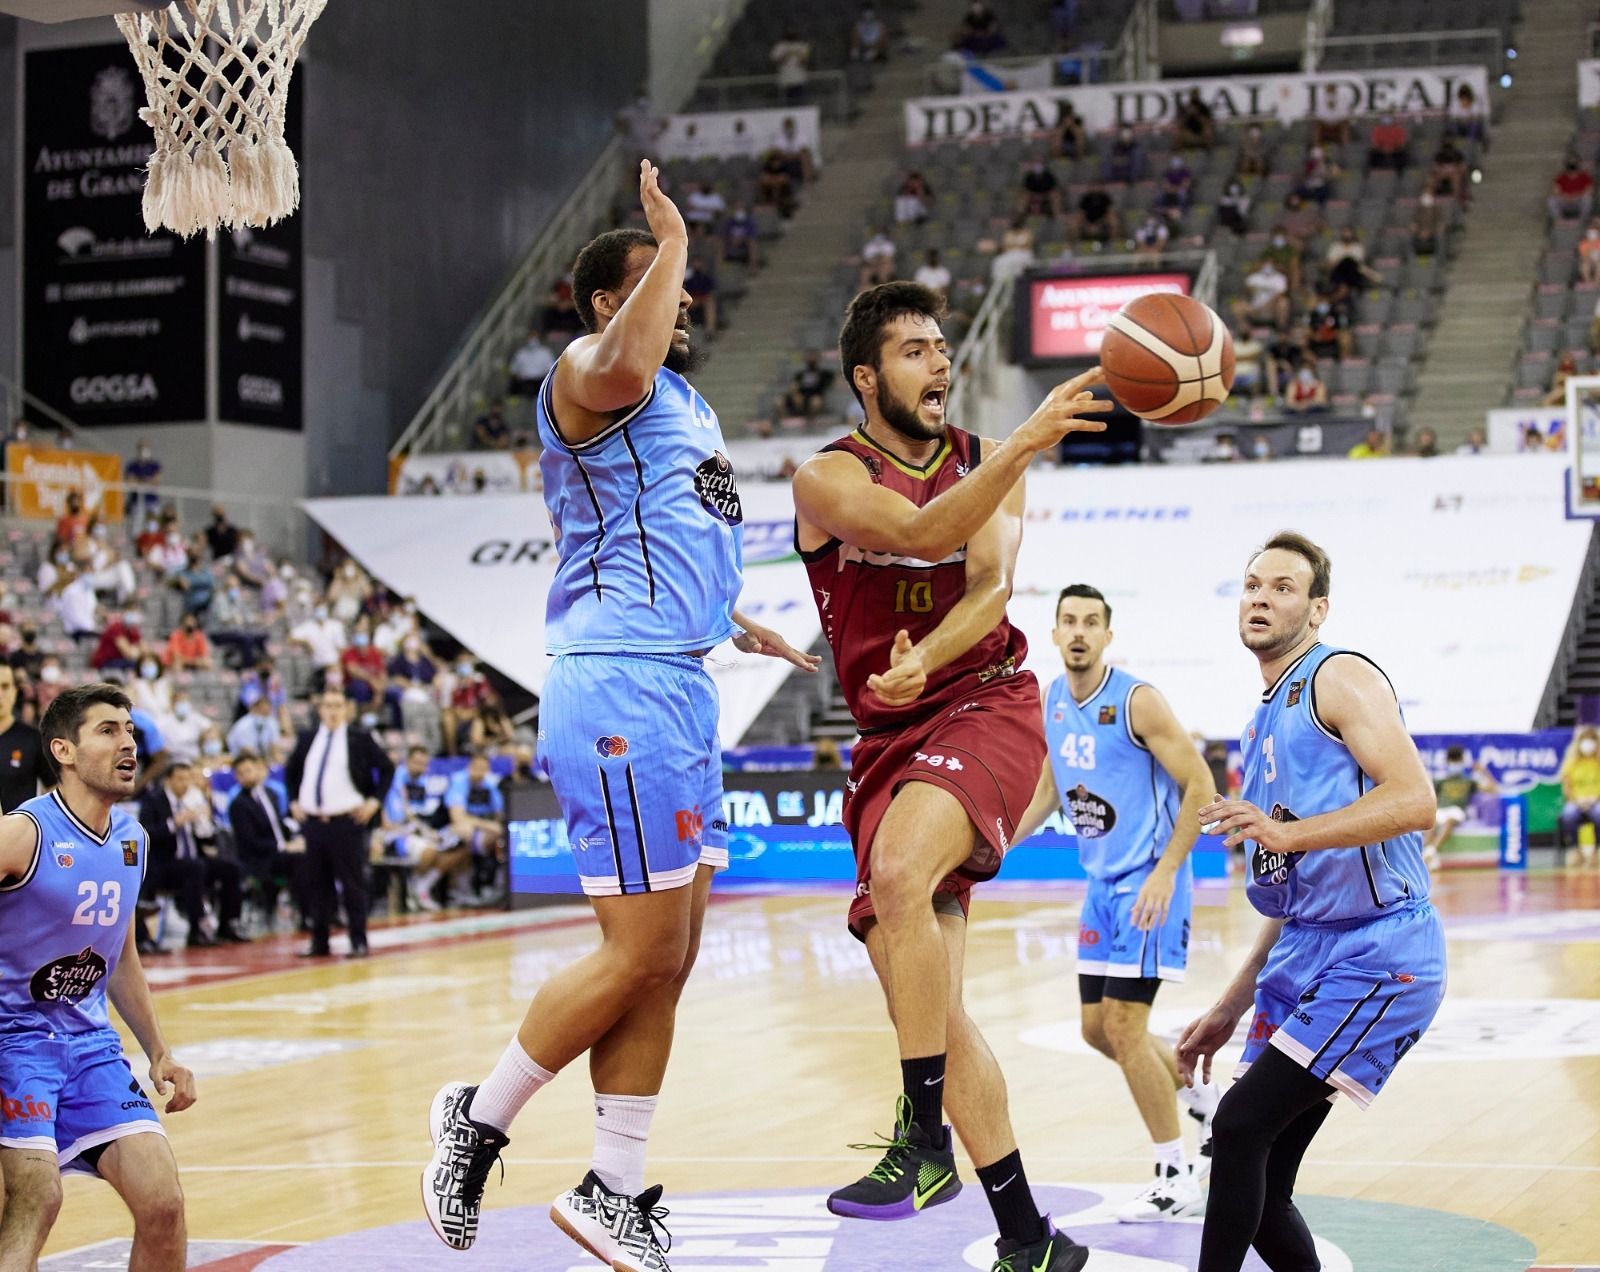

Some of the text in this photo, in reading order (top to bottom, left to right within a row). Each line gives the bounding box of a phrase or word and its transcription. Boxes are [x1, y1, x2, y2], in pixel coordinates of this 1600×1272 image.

[80, 169, 143, 197] GRAN
[895, 580, 934, 613] 10
[1060, 733, 1096, 770] 43
[1262, 734, 1277, 784] 3
[72, 880, 121, 926] 23
